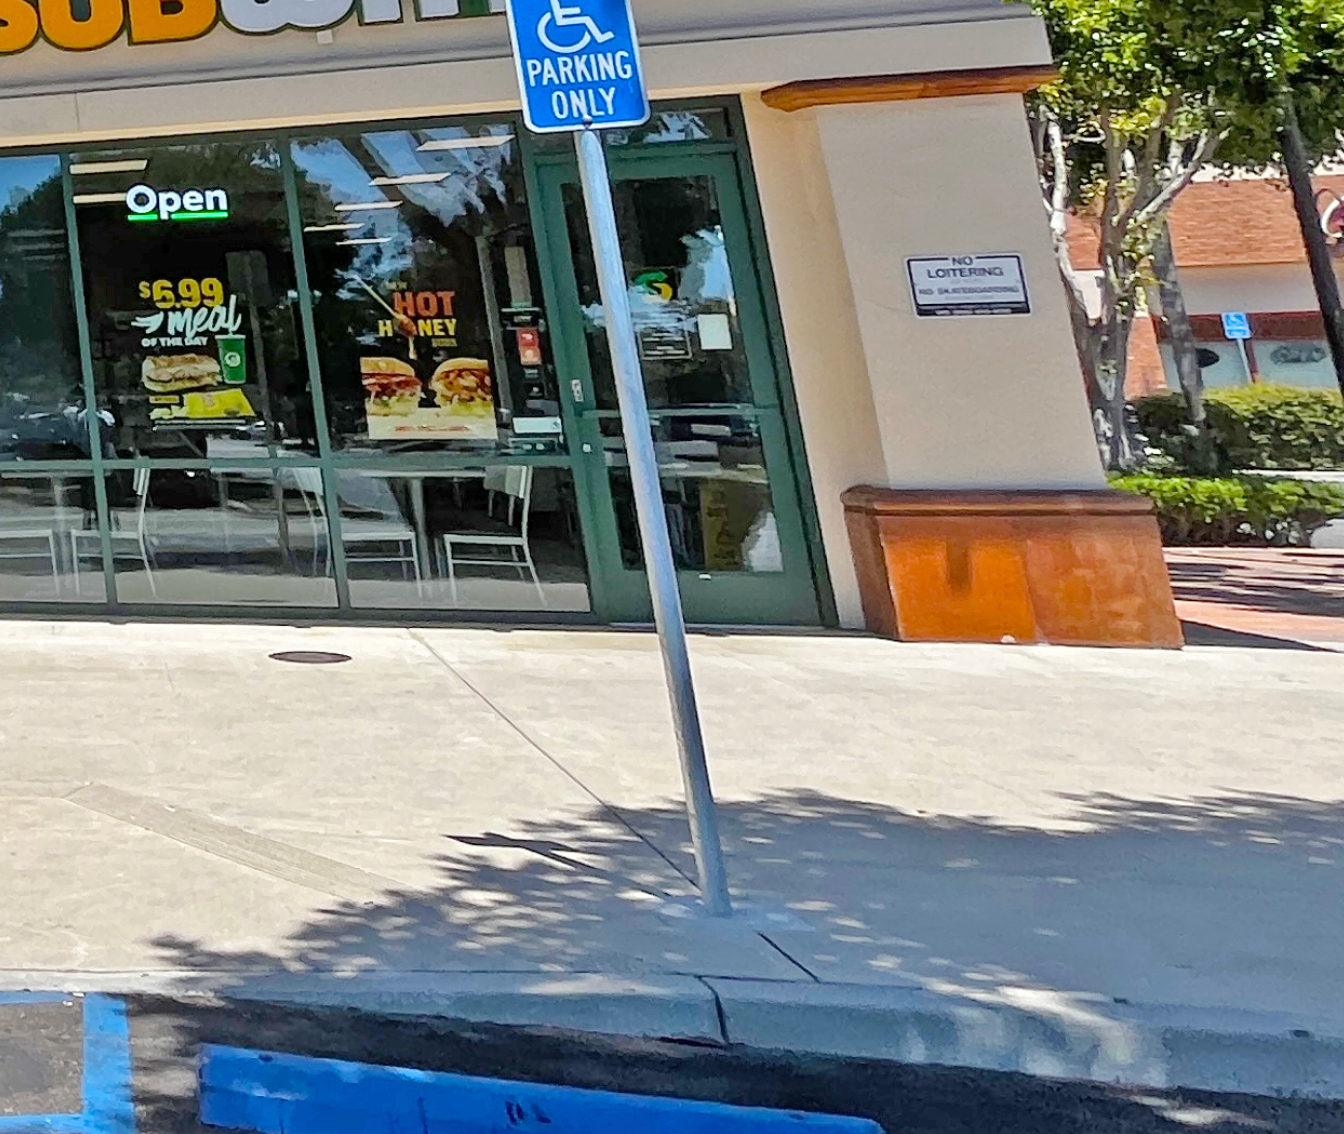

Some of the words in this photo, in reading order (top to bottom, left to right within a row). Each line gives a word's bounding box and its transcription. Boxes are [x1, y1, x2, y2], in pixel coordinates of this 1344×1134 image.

[526, 50, 633, 88] PARKING
[551, 86, 616, 119] ONLY
[126, 184, 229, 221] Open
[927, 267, 1004, 279] LOITERING
[952, 256, 974, 266] NO
[138, 277, 224, 309] $6.99
[393, 291, 456, 317] HOT
[167, 294, 242, 338] meal
[377, 318, 457, 337] HNEY
[141, 337, 158, 347] OF
[159, 336, 184, 346] THE
[184, 336, 209, 346] DAY
